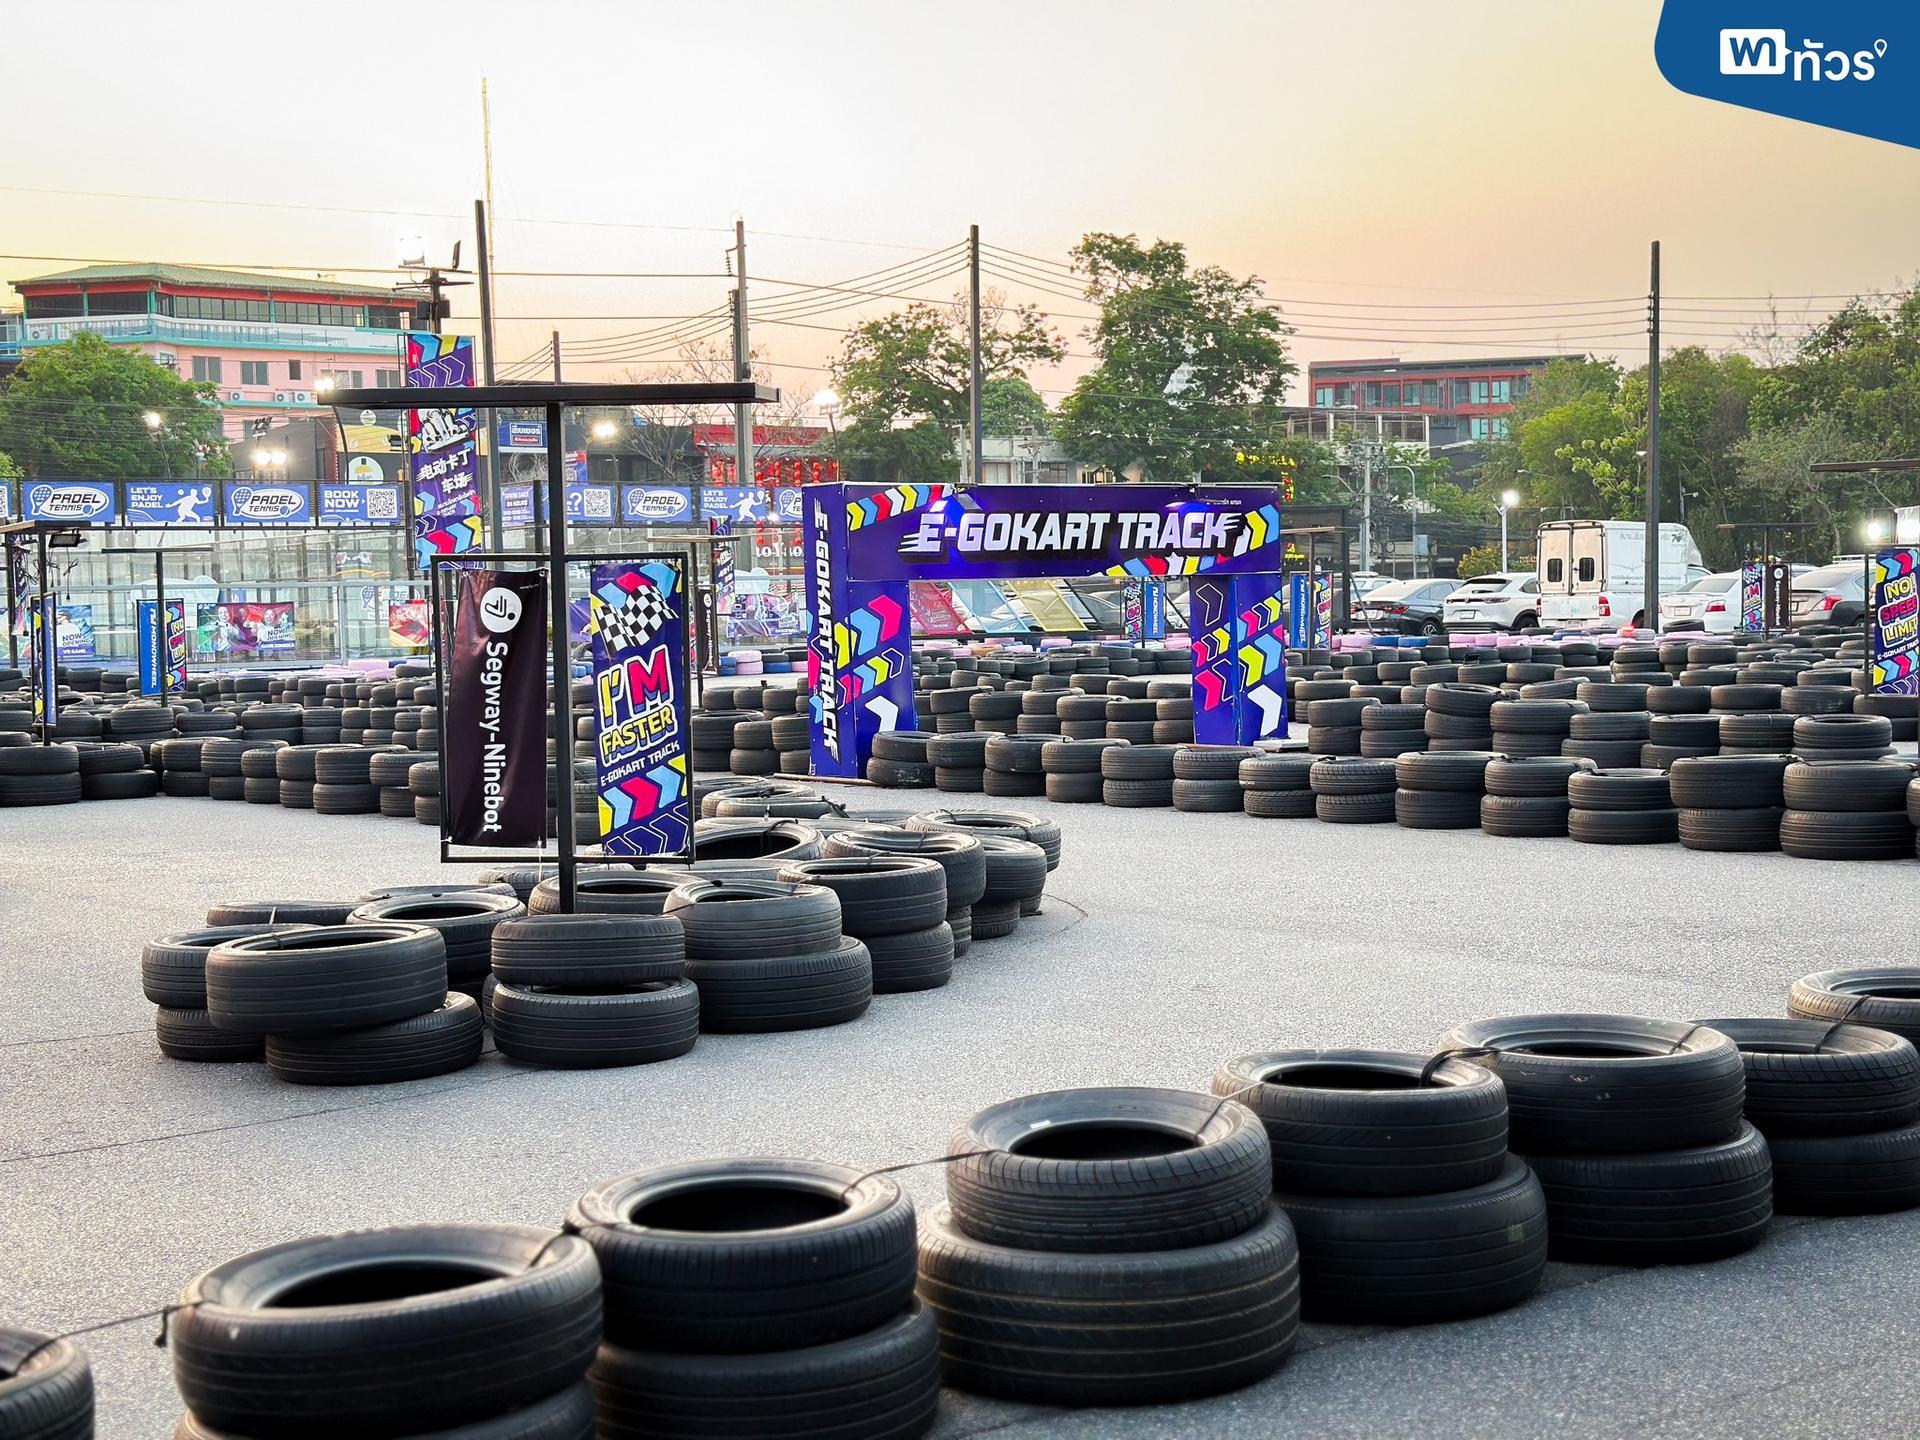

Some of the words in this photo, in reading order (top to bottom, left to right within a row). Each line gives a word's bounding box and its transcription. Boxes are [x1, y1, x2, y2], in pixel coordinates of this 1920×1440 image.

[417, 448, 471, 481] 电动卡丁
[324, 490, 359, 499] BOOK
[441, 472, 473, 493] 车场
[50, 493, 101, 504] PADEL
[131, 494, 163, 502] ENJOY
[250, 495, 296, 505] PADEL
[324, 499, 360, 508] NOW
[643, 496, 681, 505] PADEL
[898, 511, 1111, 553] E-GOKART
[1117, 511, 1242, 549] TRACK
[813, 498, 833, 655] E-GOKART
[62, 633, 82, 641] NOW
[267, 628, 285, 637] NOW
[150, 625, 158, 688] MONOWHEEL
[599, 645, 672, 730] I'M
[820, 656, 840, 764] TRACK
[479, 641, 509, 833] Segway-Ninebot
[601, 705, 675, 763] FASTER
[600, 757, 646, 787] E-GOKART
[649, 740, 680, 765] TRACK
